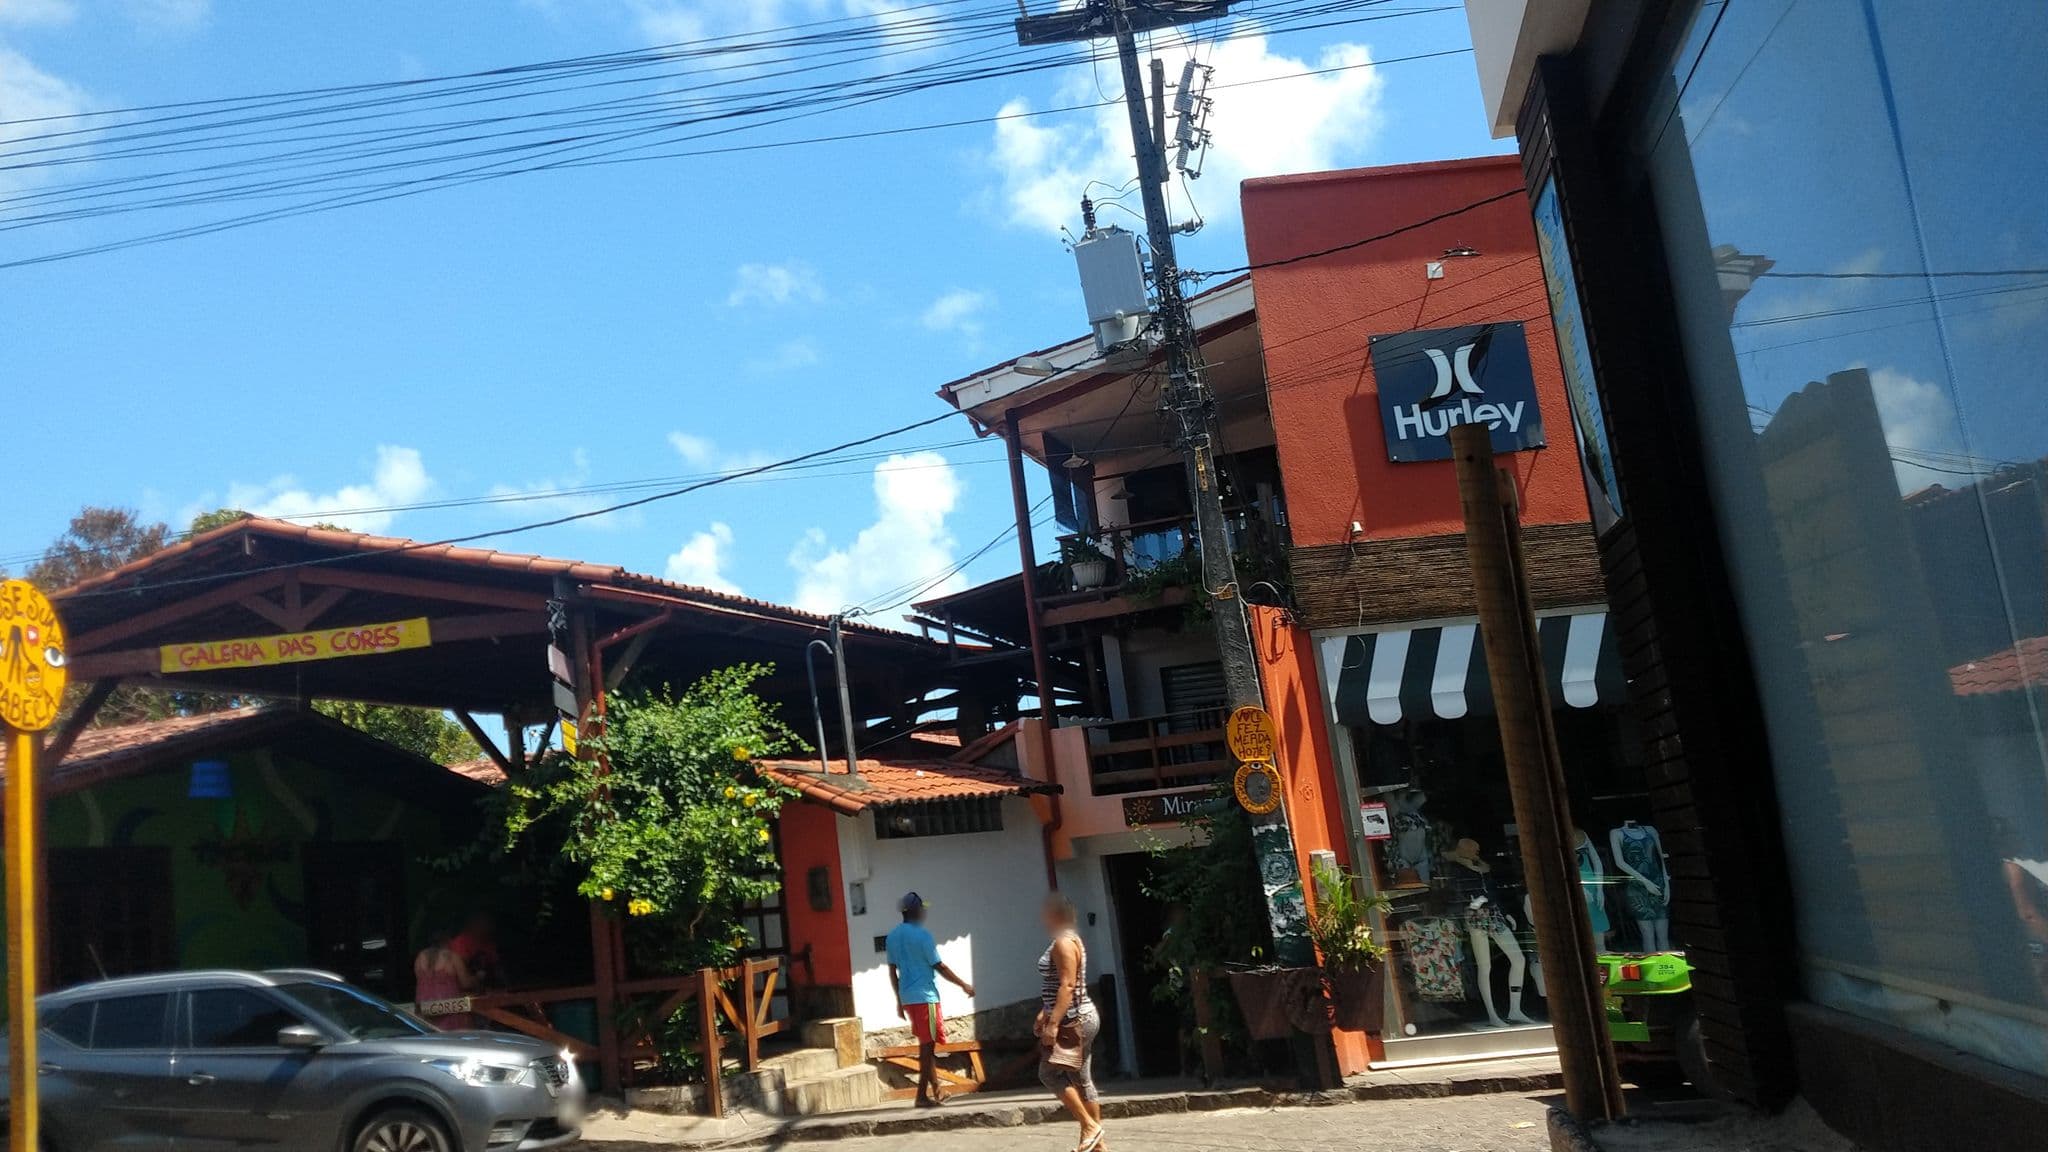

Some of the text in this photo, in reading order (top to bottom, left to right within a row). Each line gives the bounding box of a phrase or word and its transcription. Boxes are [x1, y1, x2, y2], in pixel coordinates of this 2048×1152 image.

[1393, 399, 1525, 440] Hurley
[0, 584, 24, 621] SE
[179, 626, 401, 668] GALERIA DAS CORES
[0, 680, 59, 728] ABEÇA
[1237, 723, 1266, 735] FEZ
